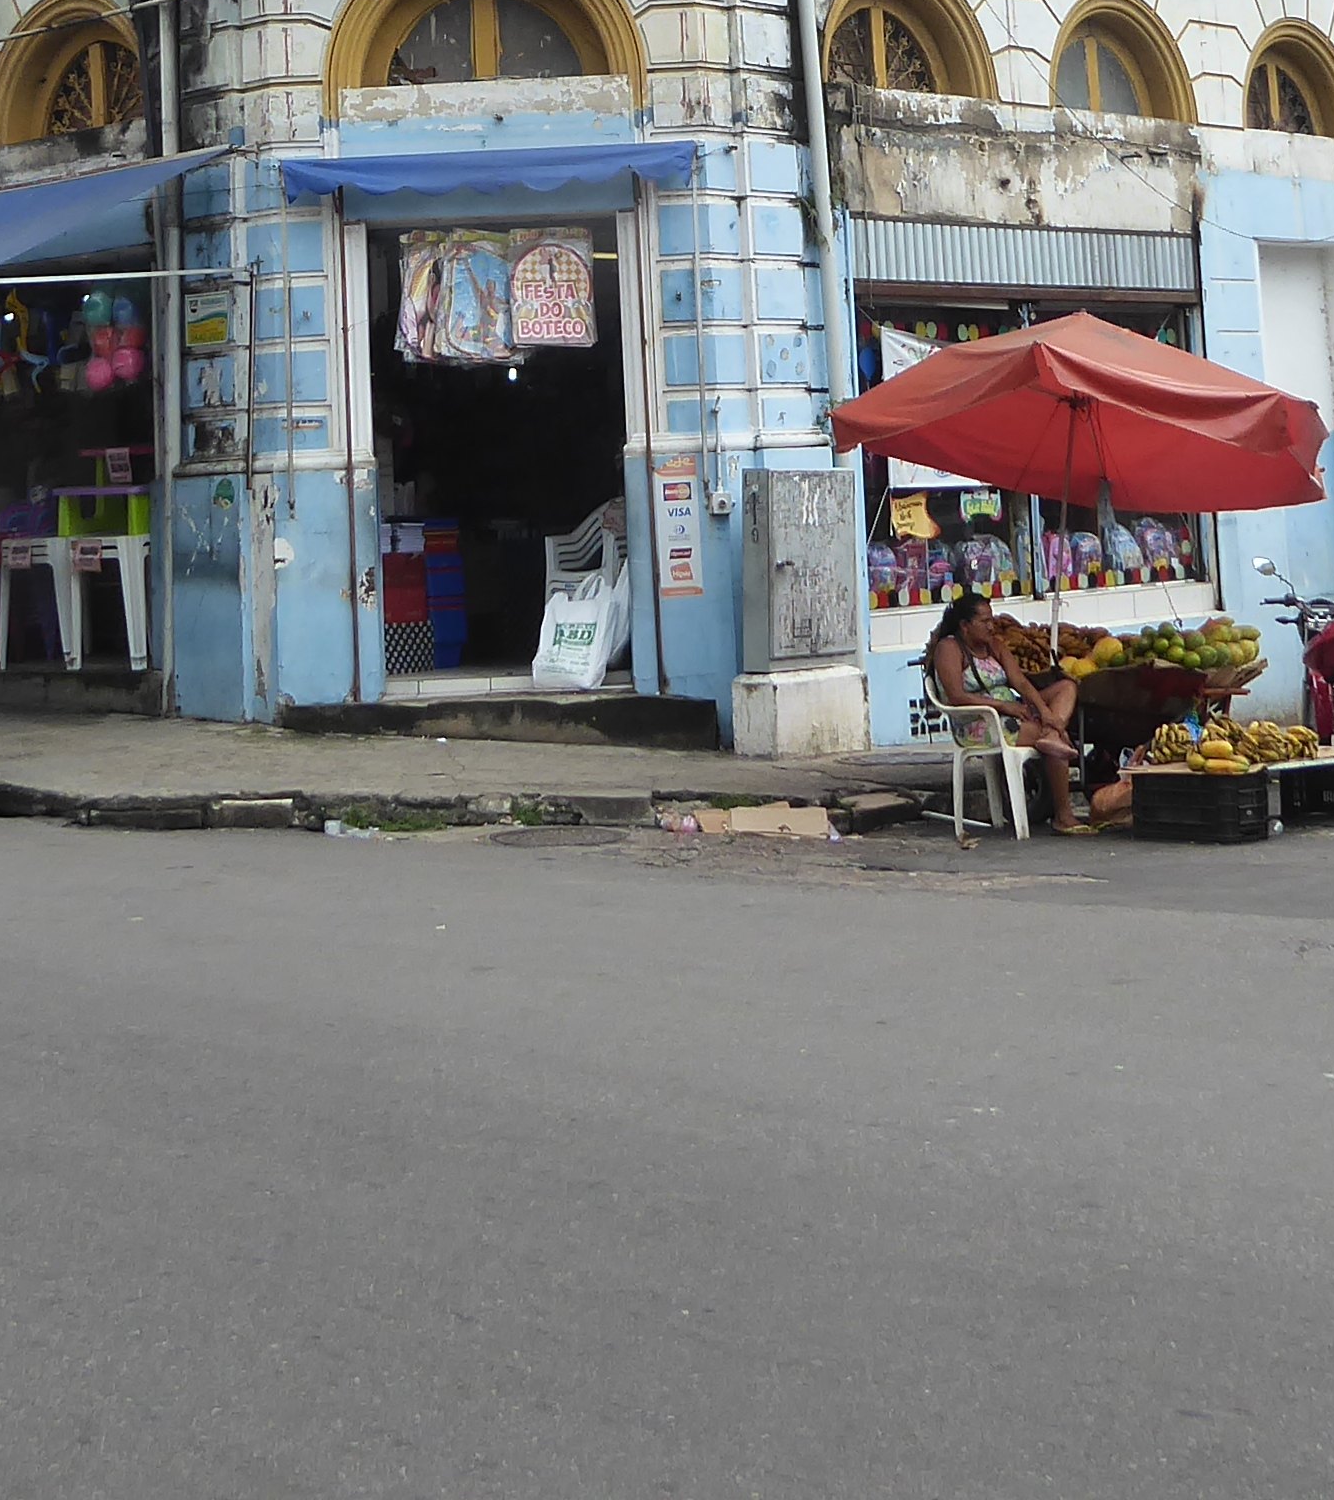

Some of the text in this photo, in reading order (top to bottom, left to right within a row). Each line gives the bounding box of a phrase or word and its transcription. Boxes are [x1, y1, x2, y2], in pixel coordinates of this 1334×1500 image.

[522, 281, 577, 301] FESTA
[538, 301, 565, 319] DO
[519, 319, 586, 338] BOTECO
[668, 507, 691, 517] VISA
